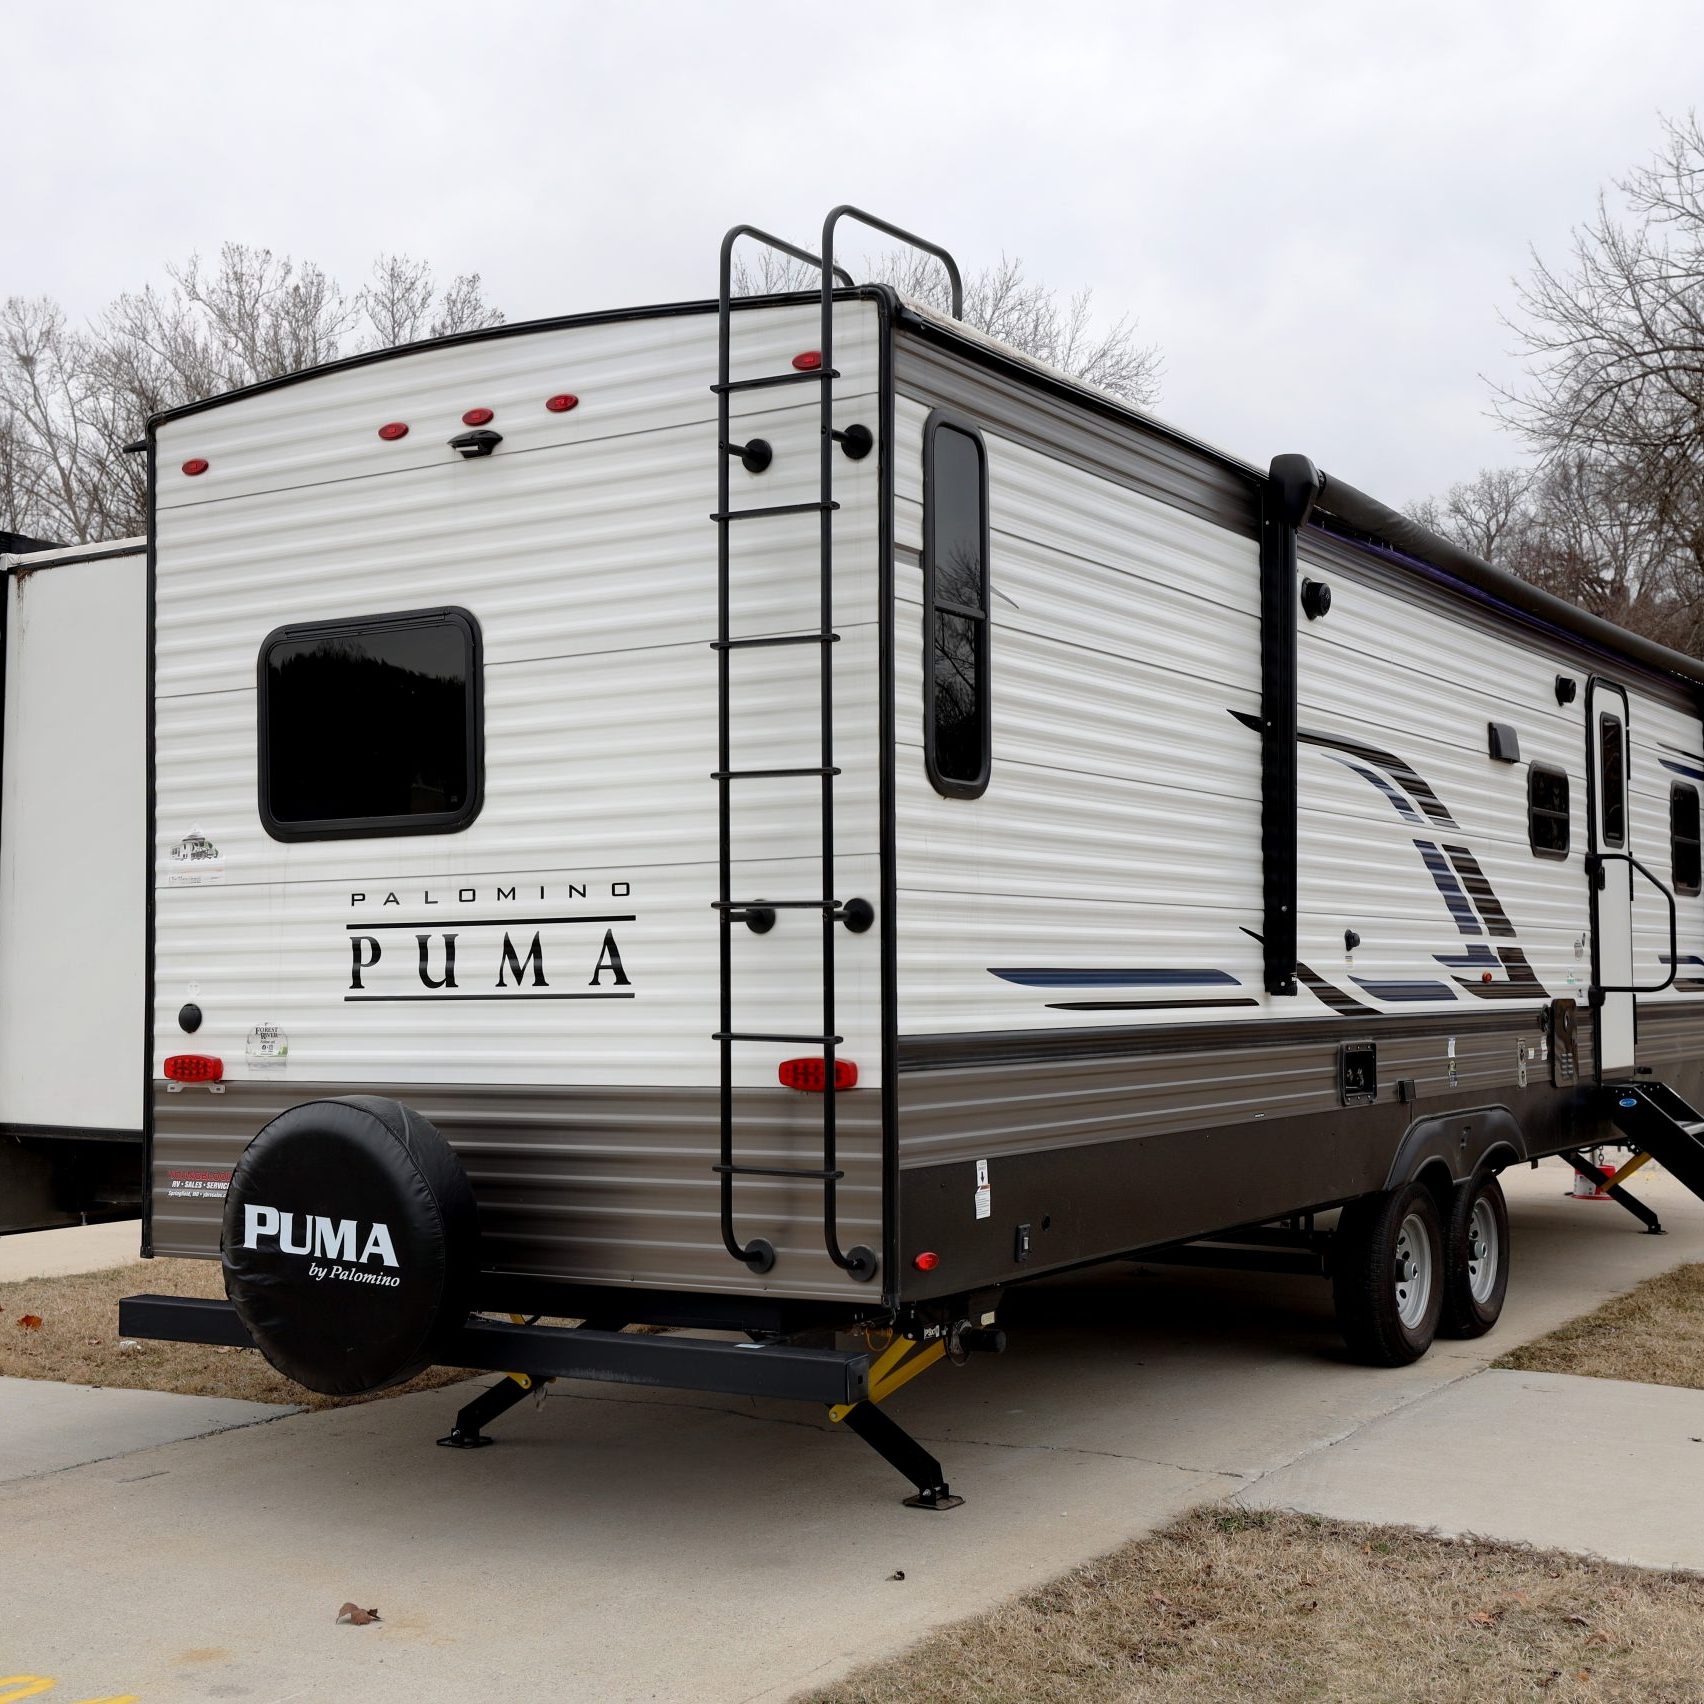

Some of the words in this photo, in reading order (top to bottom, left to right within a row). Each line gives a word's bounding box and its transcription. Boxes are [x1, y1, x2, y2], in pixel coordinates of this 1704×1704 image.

[351, 882, 630, 907] PALOMINO
[349, 928, 631, 989] PUMA
[243, 1203, 400, 1268] PUMA
[308, 1262, 327, 1281] by
[329, 1265, 400, 1287] Palomino
